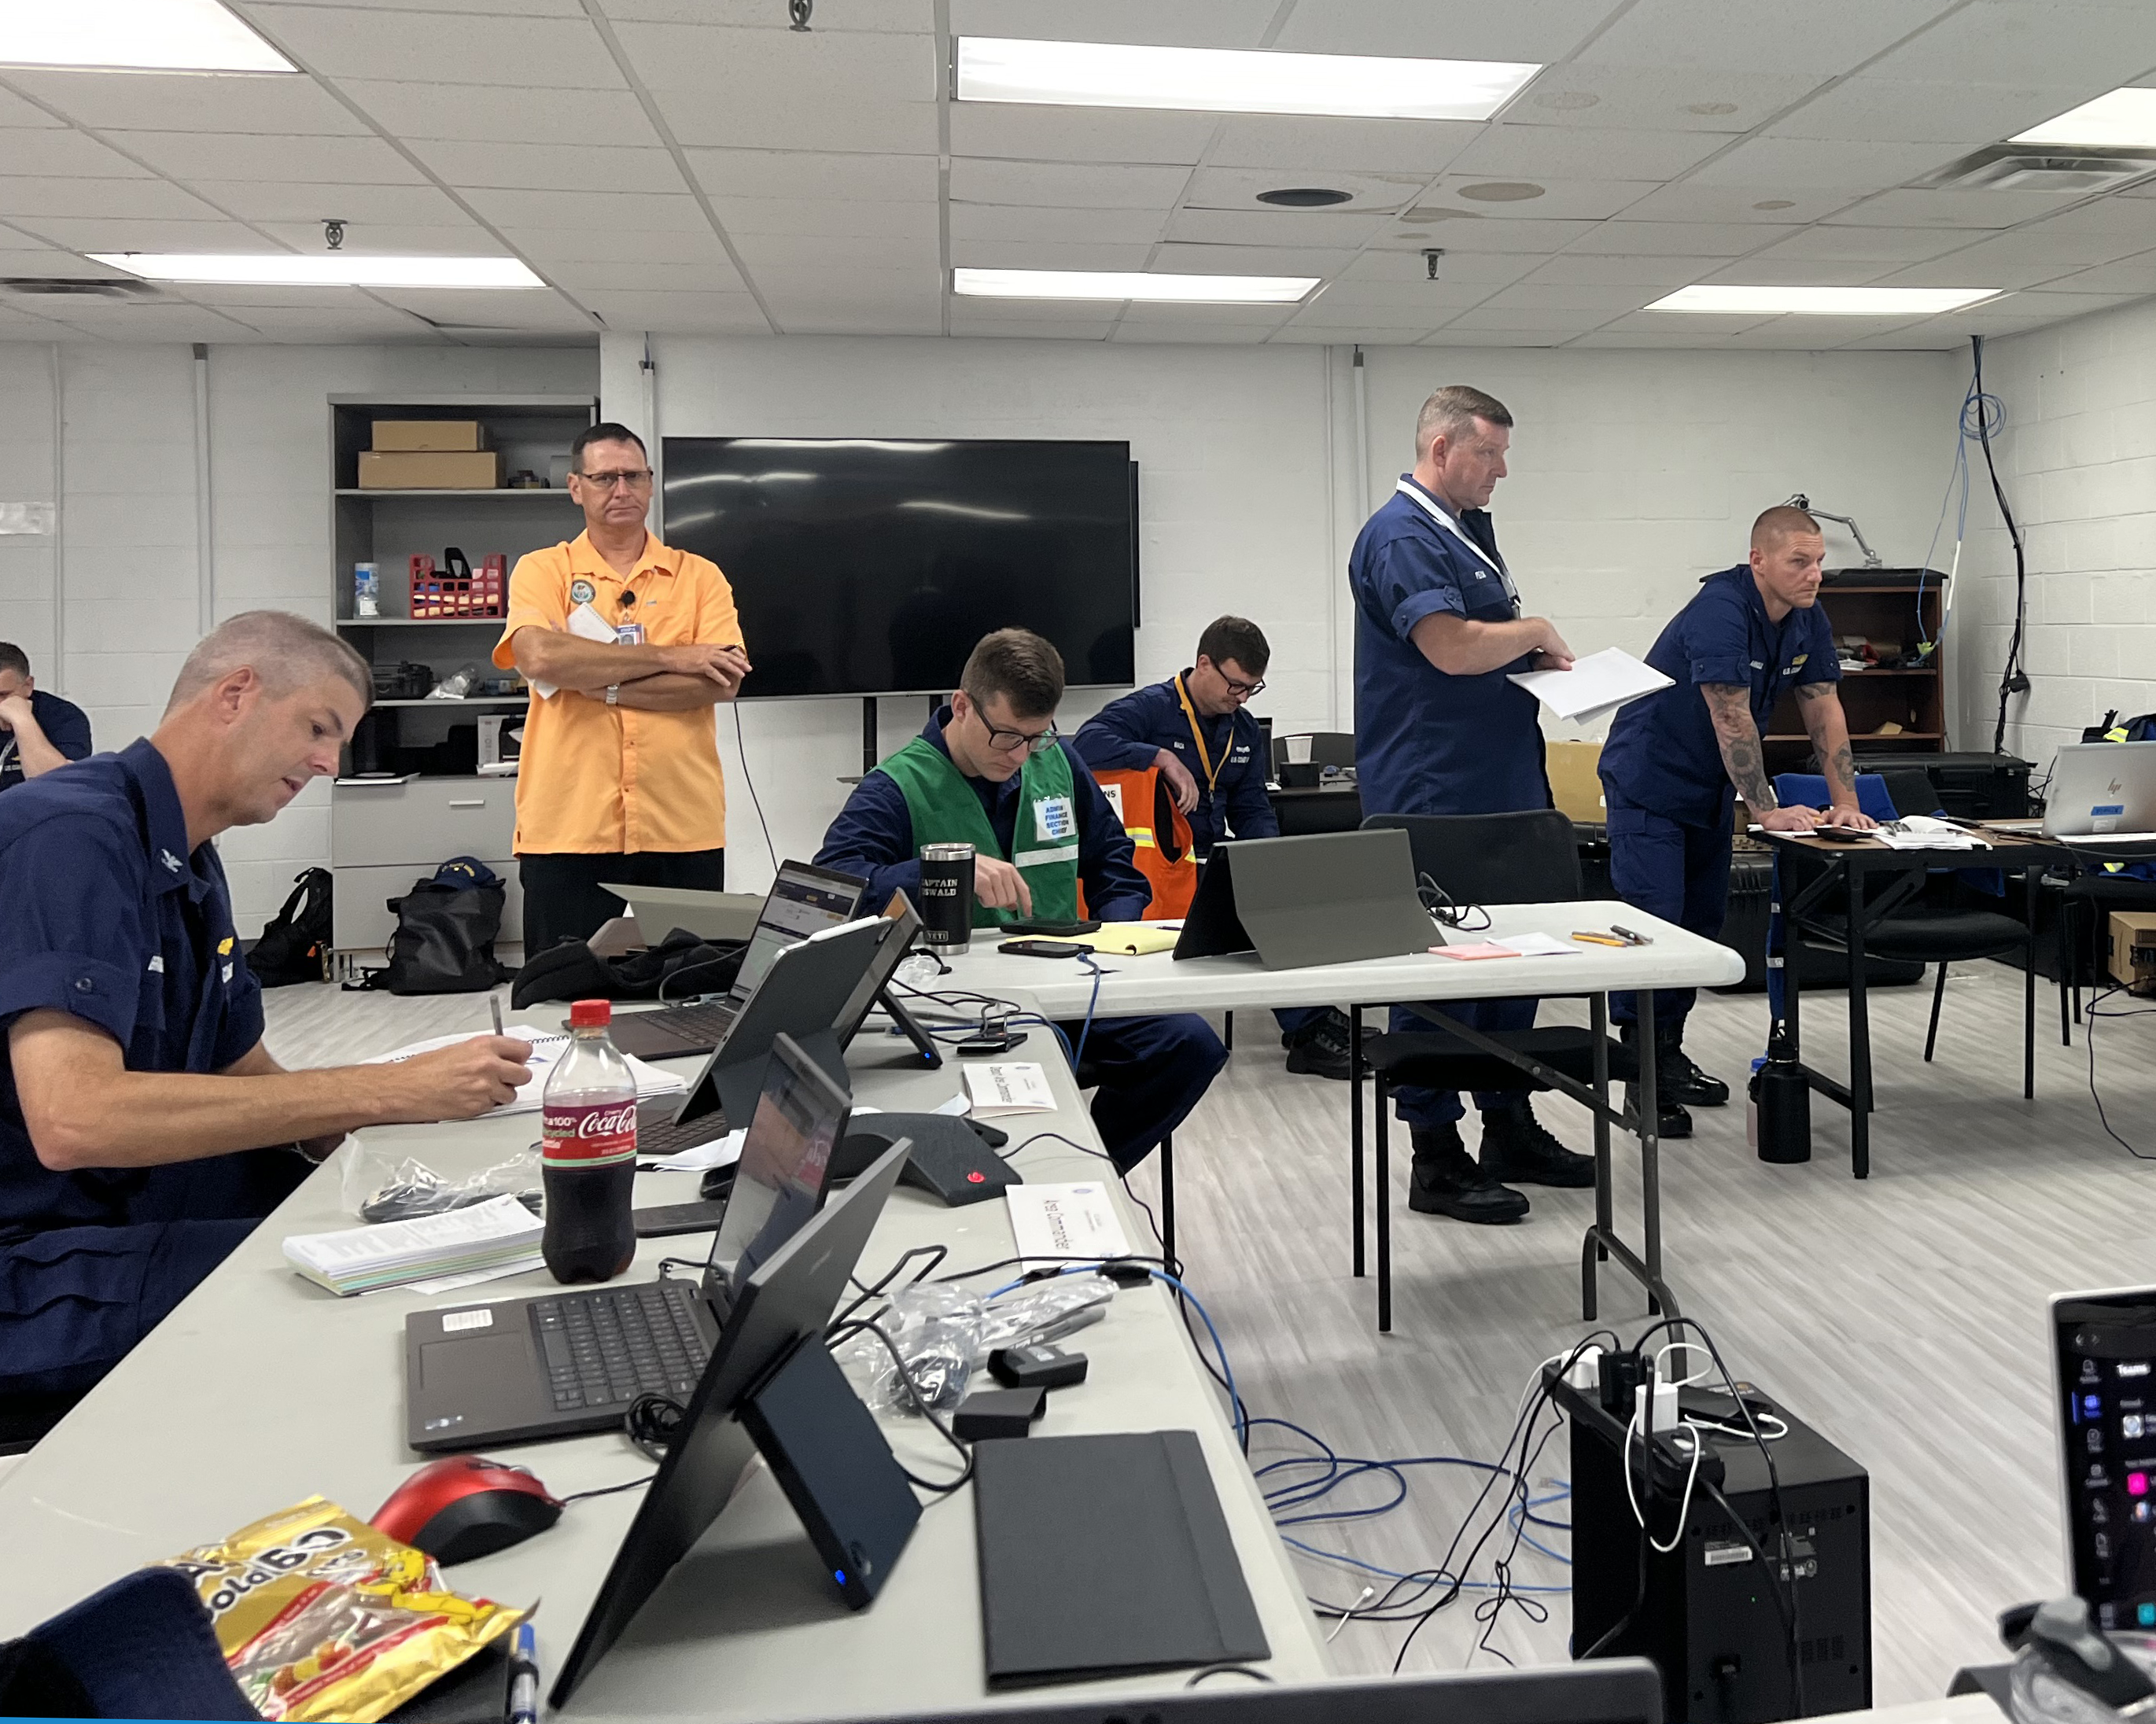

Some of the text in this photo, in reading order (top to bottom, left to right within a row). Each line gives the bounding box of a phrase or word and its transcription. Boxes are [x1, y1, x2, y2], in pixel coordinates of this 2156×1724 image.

[1045, 812, 1067, 821] FINANCE
[1047, 820, 1069, 828] SECTION
[1052, 827, 1067, 835] CHIEF
[1047, 1212, 1071, 1250] Commander
[2116, 1364, 2150, 1377] Teams
